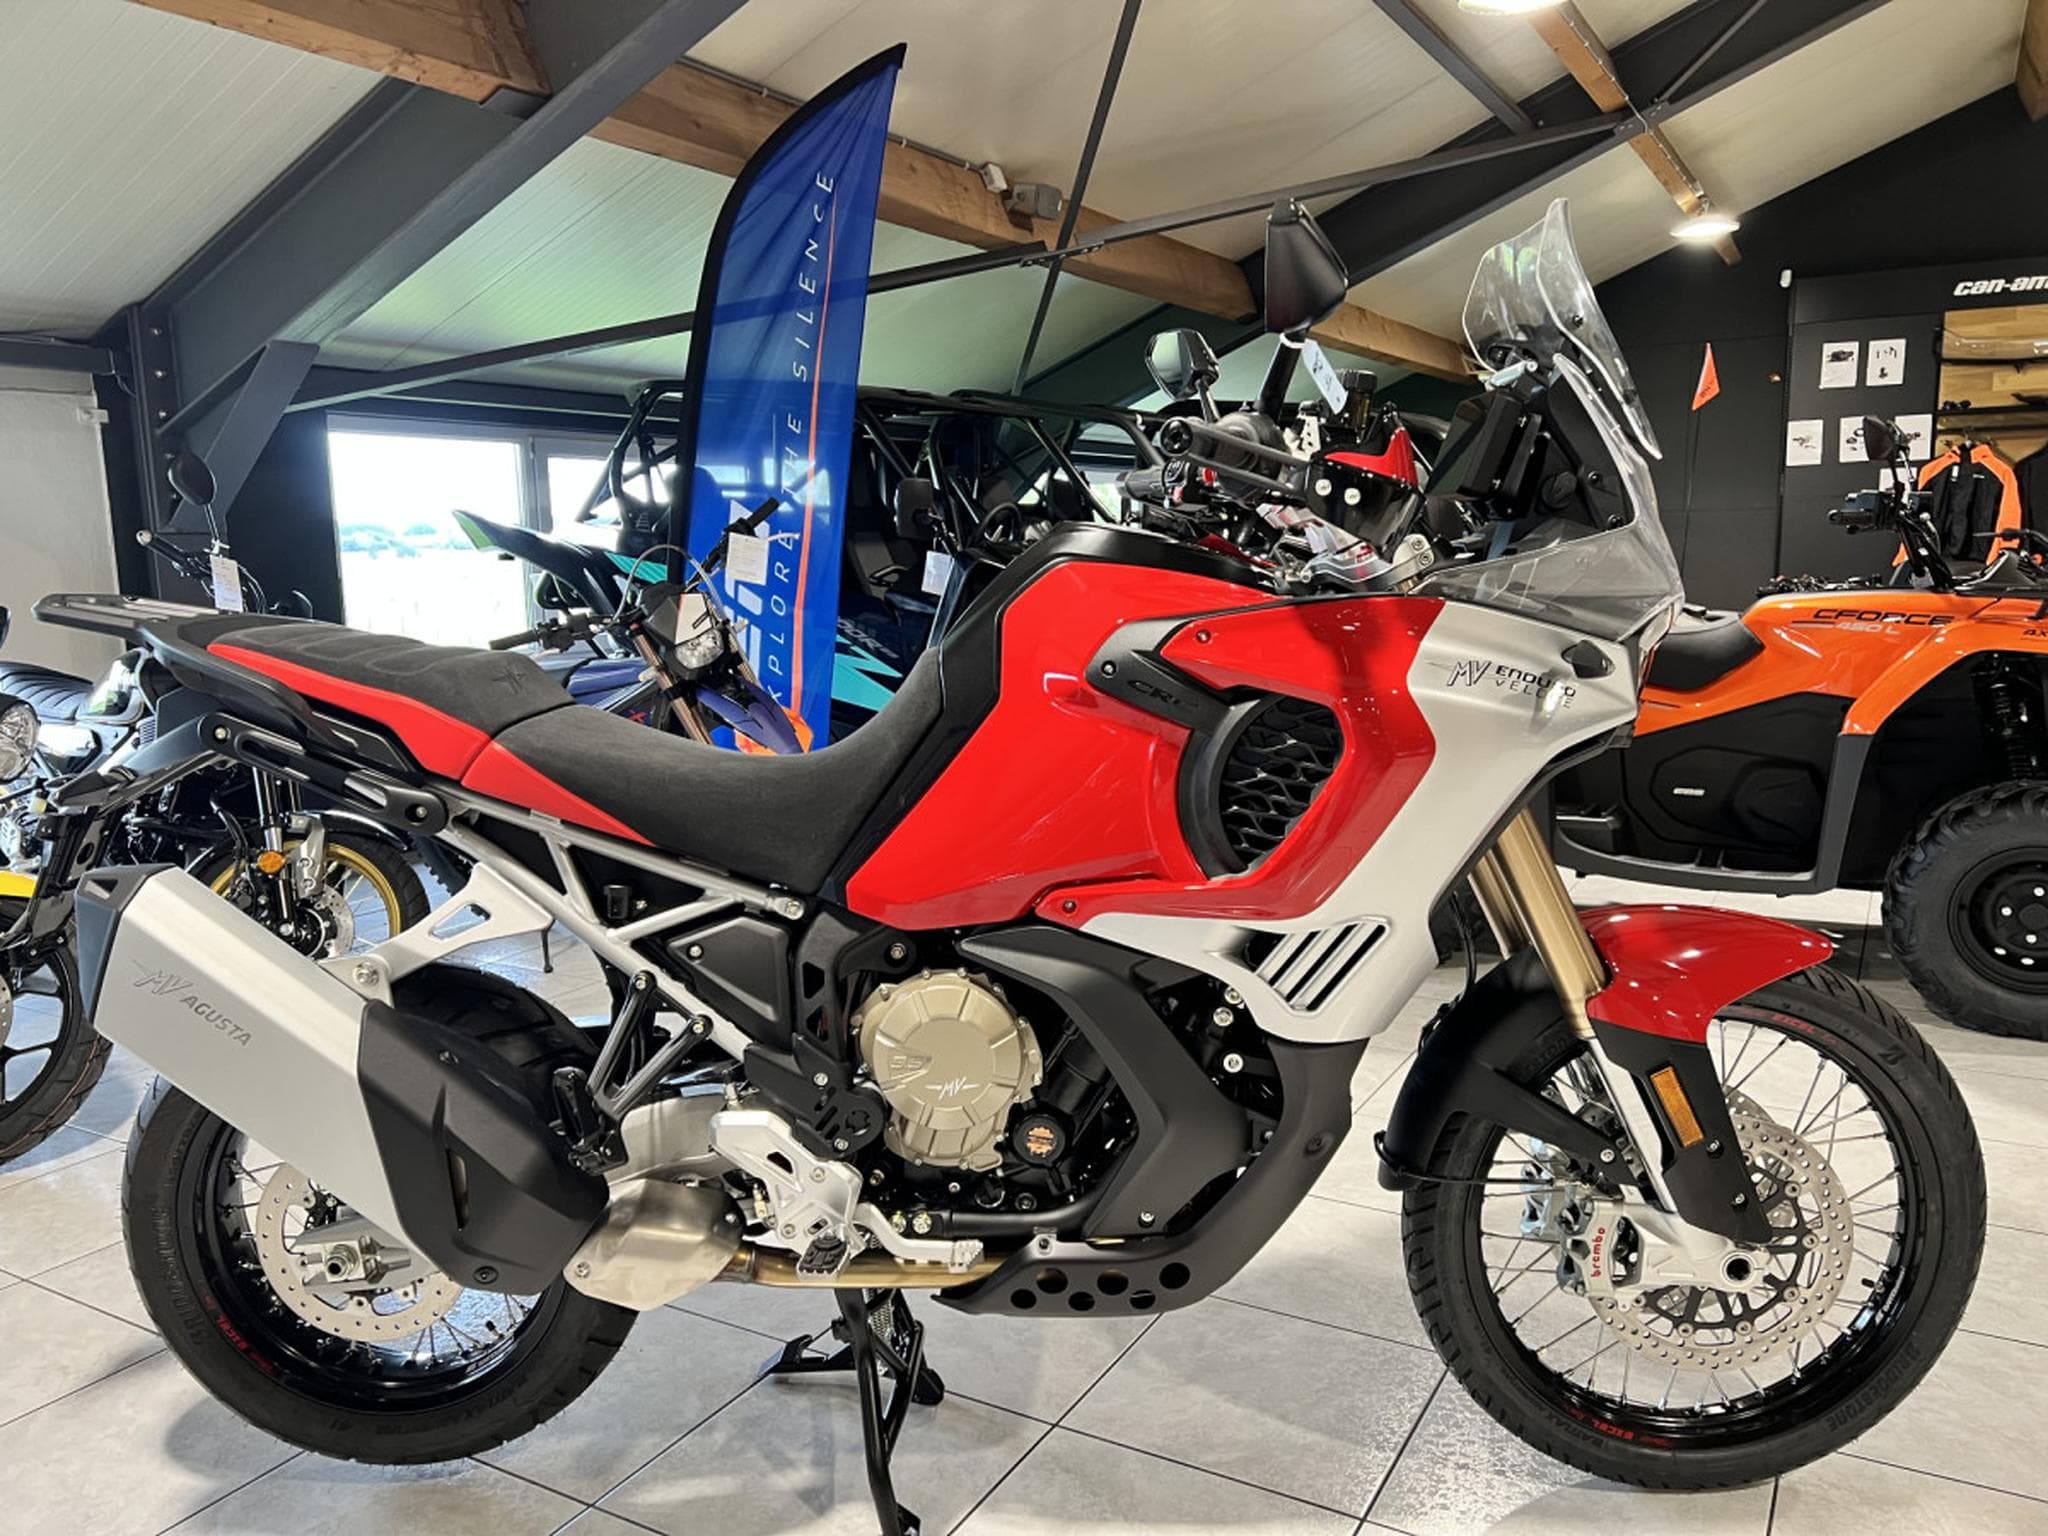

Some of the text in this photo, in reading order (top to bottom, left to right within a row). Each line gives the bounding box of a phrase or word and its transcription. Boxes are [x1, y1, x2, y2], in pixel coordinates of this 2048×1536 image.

[1953, 275, 2048, 296] can-am
[767, 529, 794, 704] XPLORE
[793, 171, 834, 382] SILENCE
[1813, 608, 1955, 626] CFORCE
[1495, 664, 1577, 698] ENDUO
[180, 994, 253, 1047] AGUSTA
[1590, 1226, 1606, 1278] brembo
